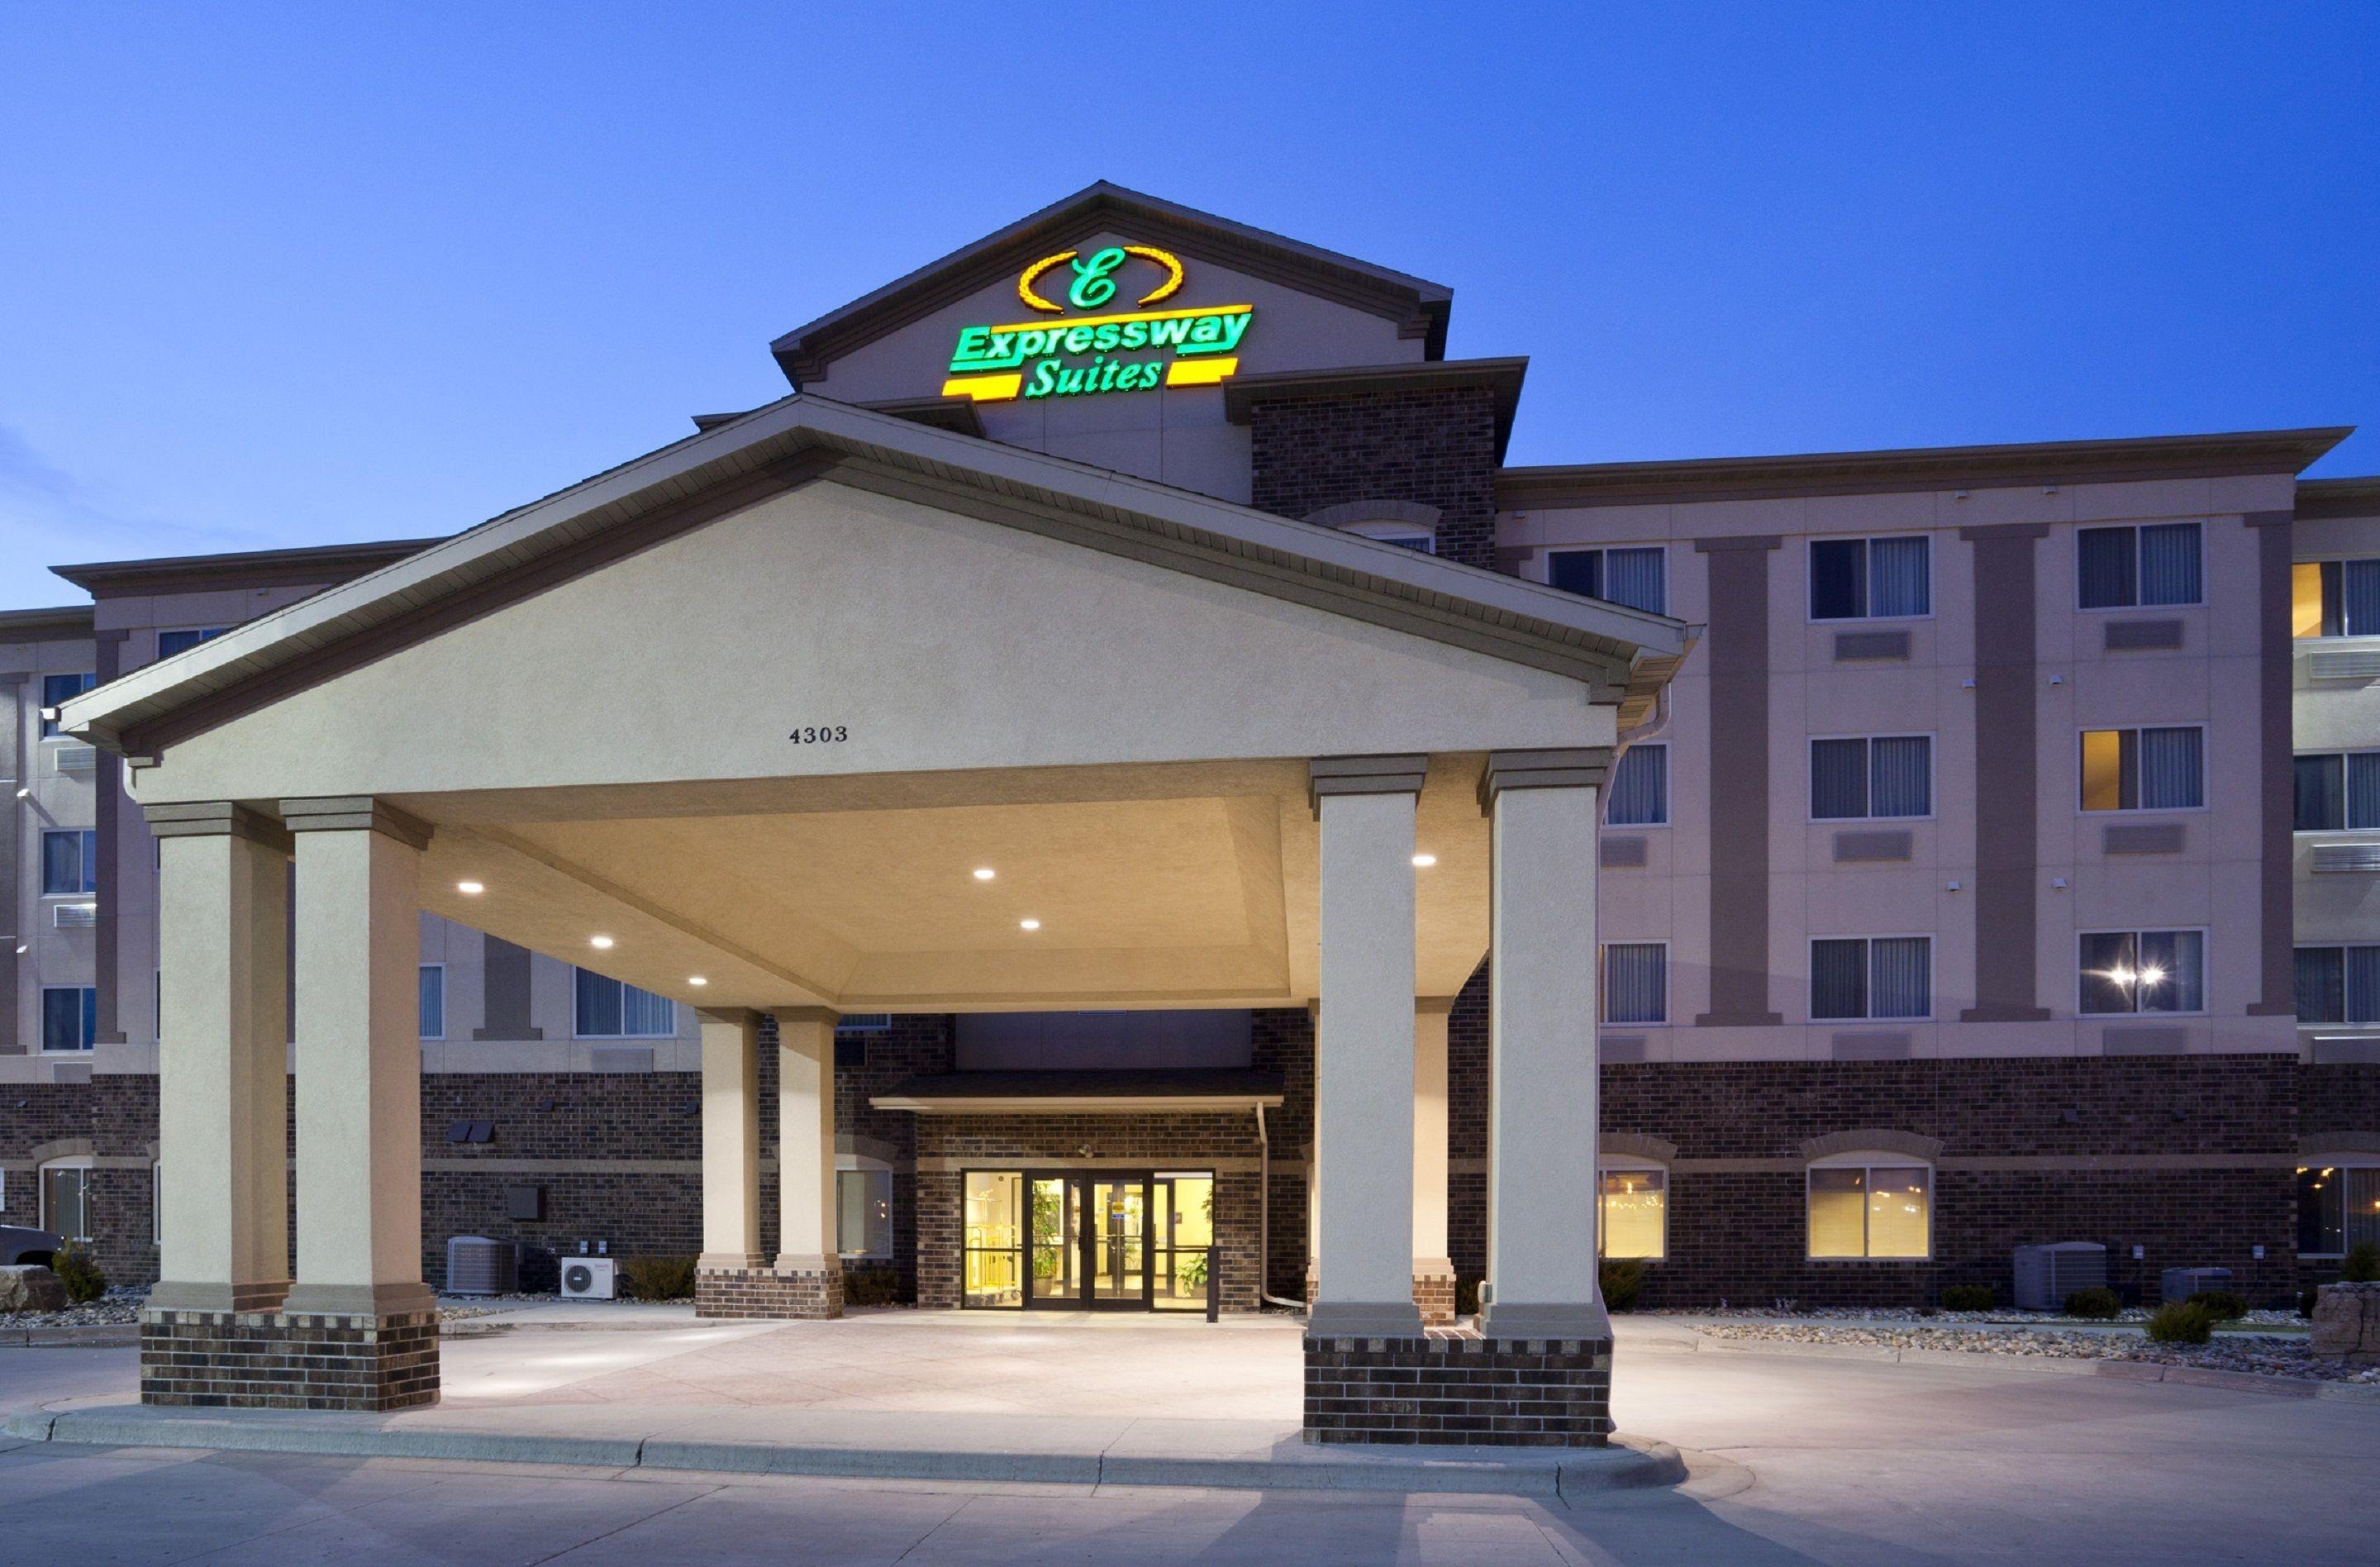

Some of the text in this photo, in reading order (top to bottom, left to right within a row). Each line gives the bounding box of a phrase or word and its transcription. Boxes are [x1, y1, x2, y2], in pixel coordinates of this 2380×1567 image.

[1069, 247, 1126, 309] E
[950, 312, 1254, 372] Expressway
[1025, 355, 1164, 398] Suites
[789, 726, 848, 745] 4303
